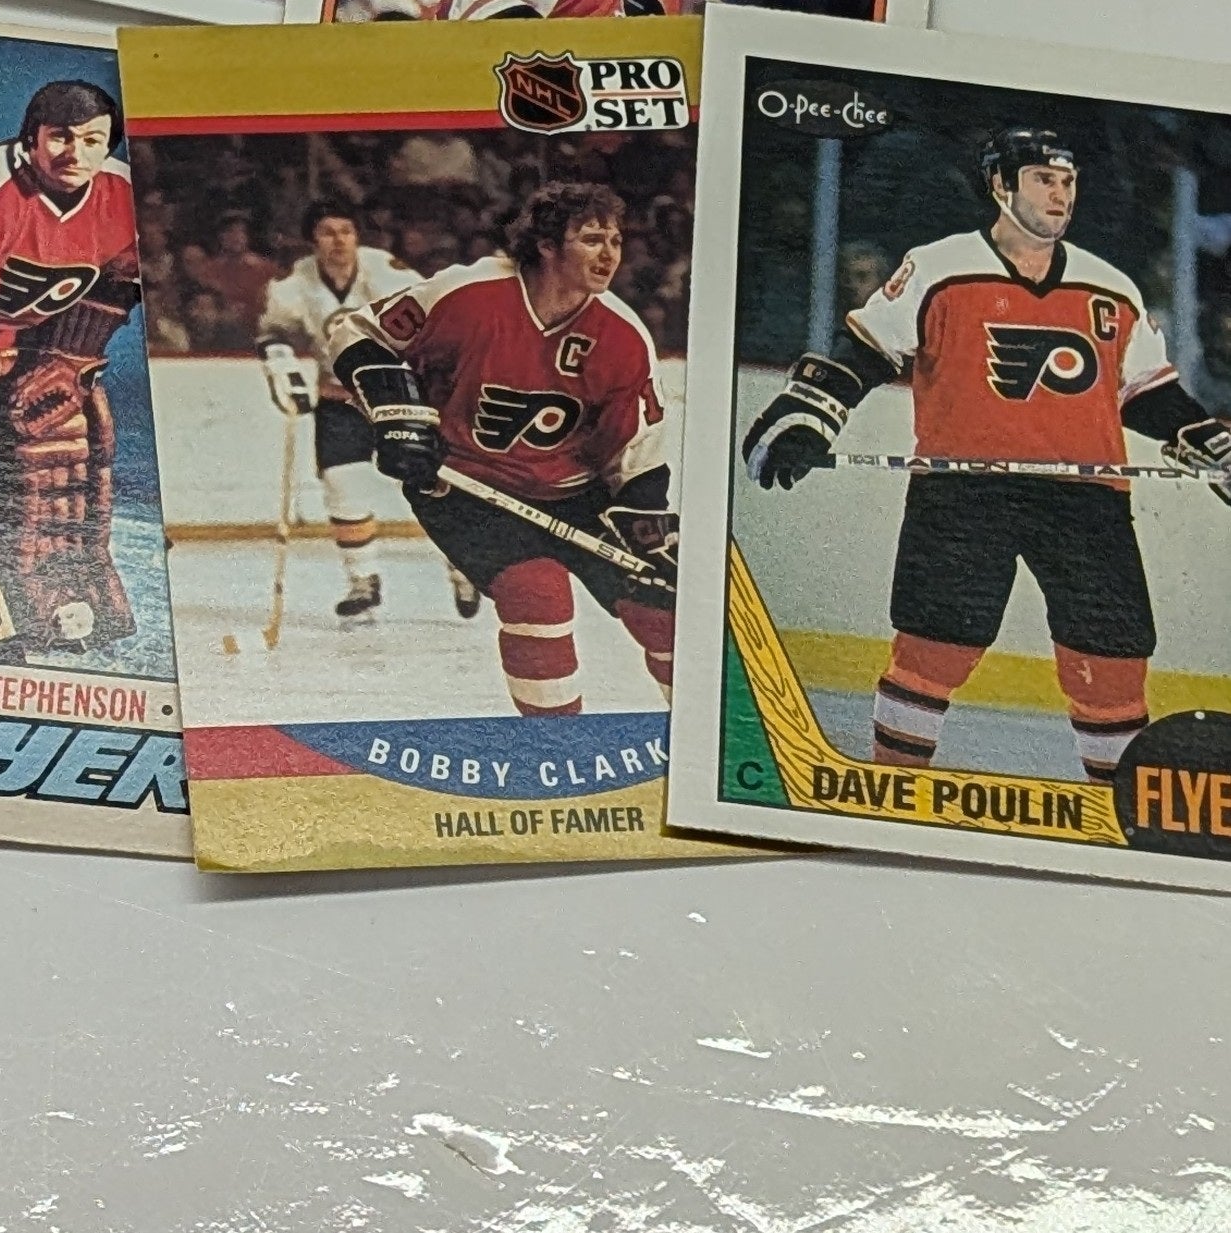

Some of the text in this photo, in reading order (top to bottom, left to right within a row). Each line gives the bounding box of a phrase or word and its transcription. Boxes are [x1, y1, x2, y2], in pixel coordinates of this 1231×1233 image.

[516, 71, 572, 116] NHL
[588, 60, 681, 90] PRO
[593, 97, 685, 129] SET
[1087, 294, 1120, 342] C
[555, 333, 598, 377] C
[368, 738, 511, 788] BOBBY
[736, 760, 765, 792] C
[812, 765, 1084, 831] DAVE POULIN
[435, 806, 645, 838] HALL OF FAMER
